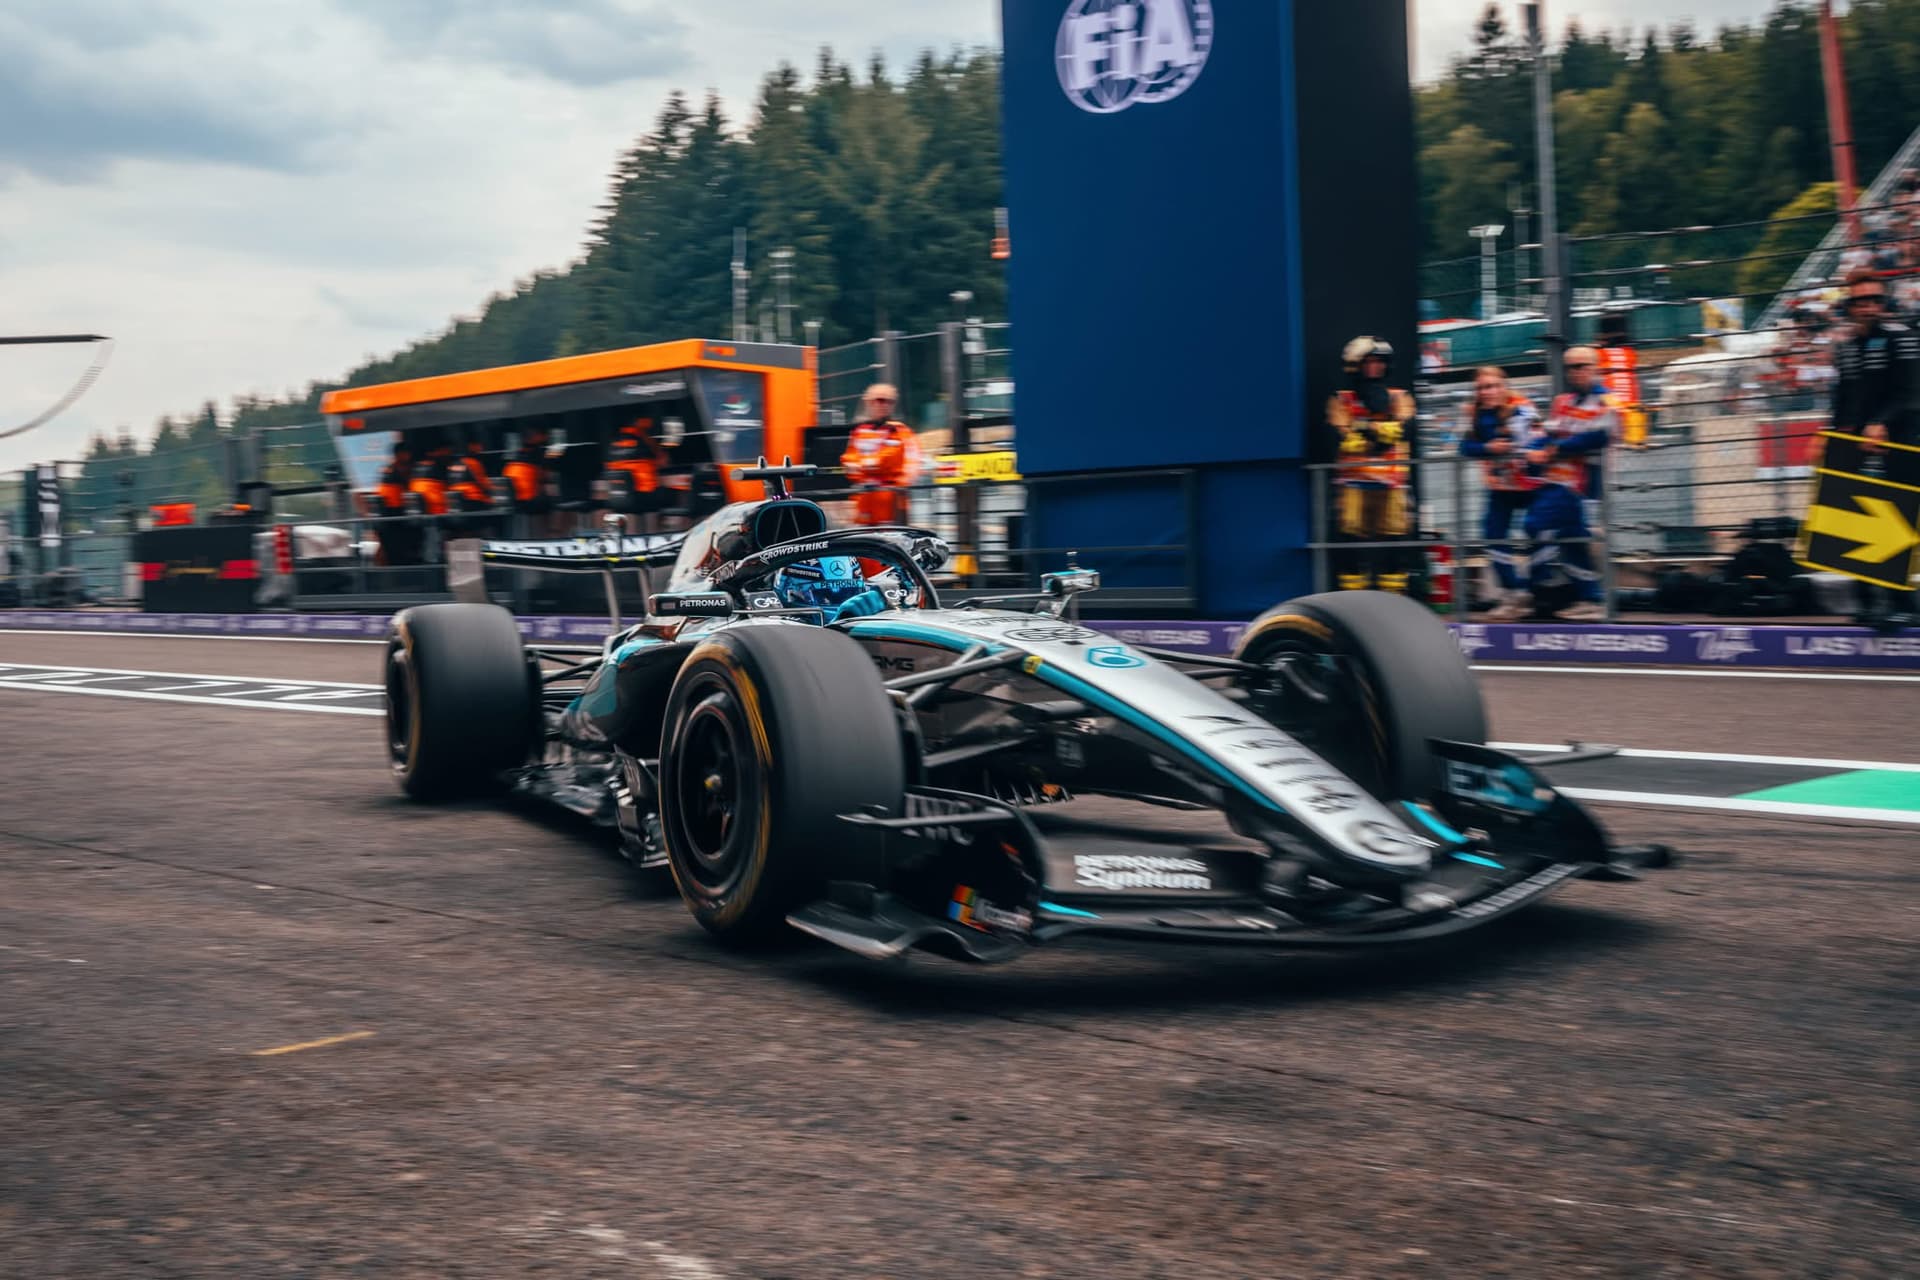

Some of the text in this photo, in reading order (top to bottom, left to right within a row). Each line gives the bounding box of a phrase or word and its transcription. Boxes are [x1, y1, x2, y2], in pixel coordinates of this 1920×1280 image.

[762, 541, 829, 562] CROWDSTRIKE
[679, 599, 726, 607] PETRONAS
[1512, 633, 1570, 650] LAS
